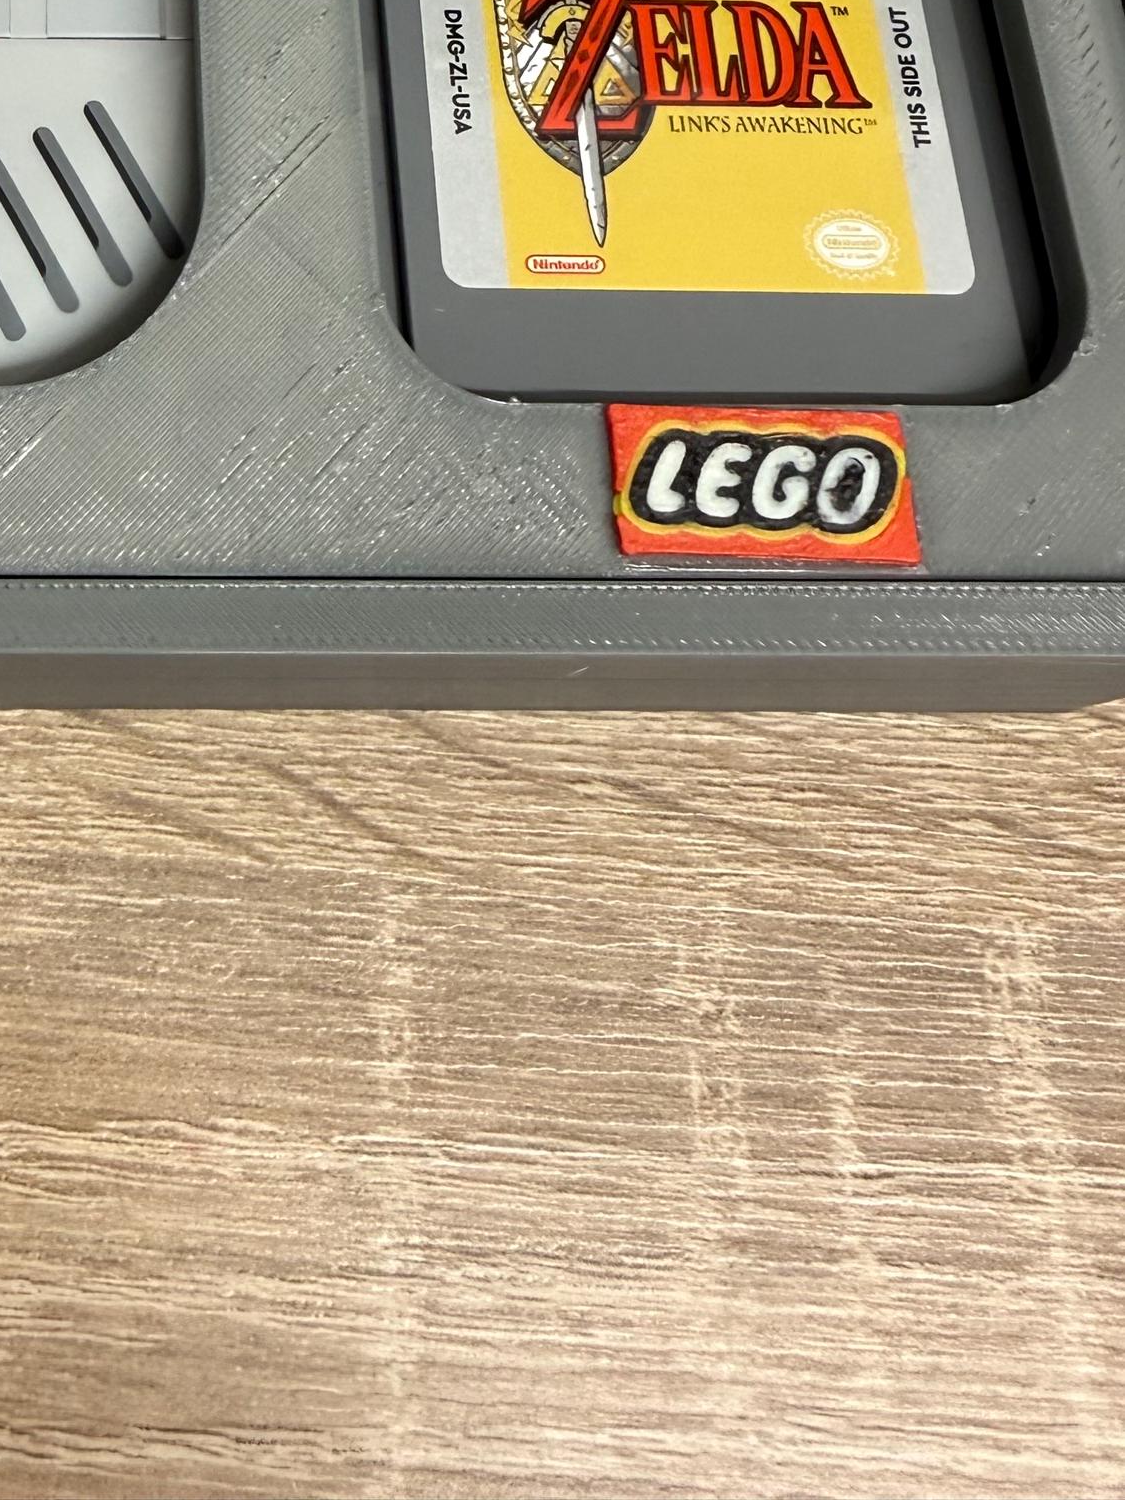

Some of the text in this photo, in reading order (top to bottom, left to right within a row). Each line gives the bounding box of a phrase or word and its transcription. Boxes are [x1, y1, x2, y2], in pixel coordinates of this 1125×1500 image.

[444, 9, 473, 135] DMG-ZL-USA
[668, 114, 731, 134] LINK'S
[736, 115, 864, 135] AWAKENING
[888, 6, 932, 149] THIS SIDE OUT
[645, 440, 881, 525] LEGO
